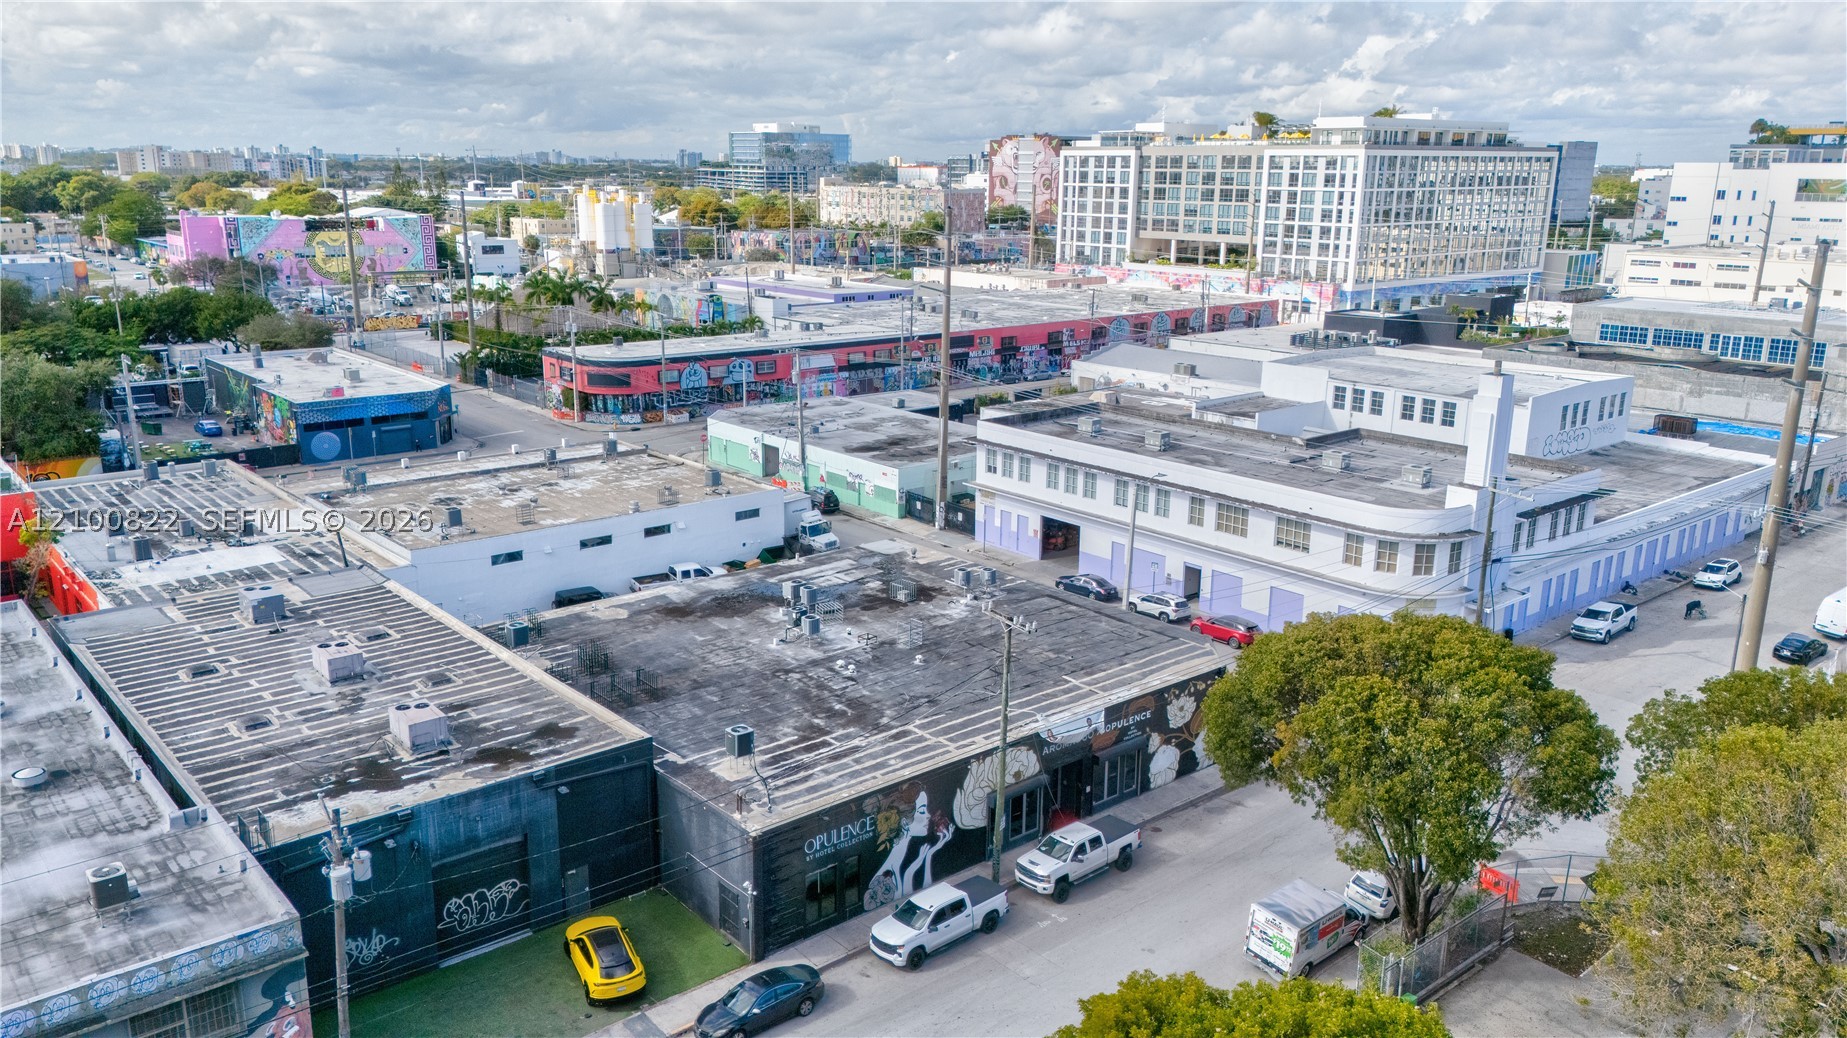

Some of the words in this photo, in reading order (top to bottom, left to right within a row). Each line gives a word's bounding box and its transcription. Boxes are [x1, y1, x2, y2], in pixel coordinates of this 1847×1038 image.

[1105, 709, 1152, 732] OPULENCE
[804, 815, 875, 853] OPULENCE
[815, 846, 836, 859] HOTEL
[837, 832, 872, 849] COLLECTION
